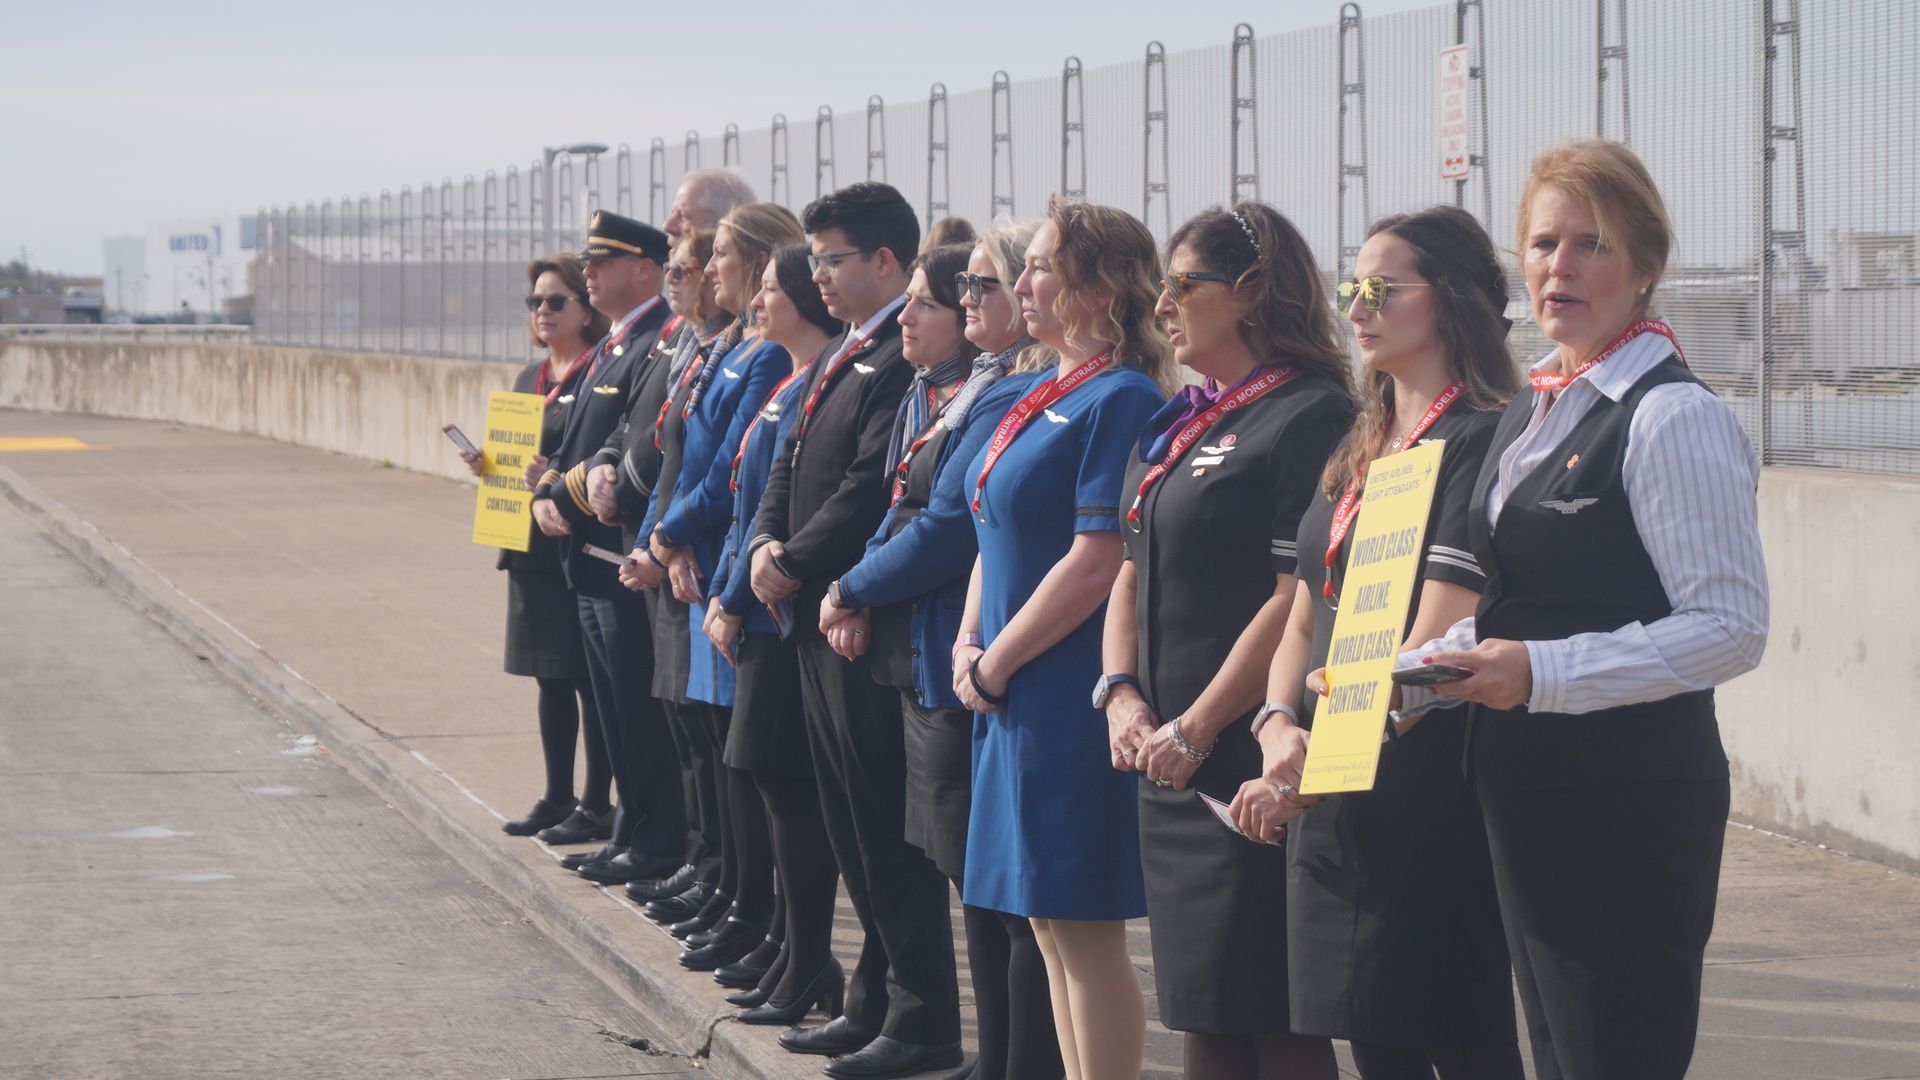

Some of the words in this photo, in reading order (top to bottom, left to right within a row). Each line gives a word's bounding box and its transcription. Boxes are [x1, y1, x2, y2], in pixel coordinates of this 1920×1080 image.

[1058, 359, 1100, 391] CONTRACT
[1220, 400, 1237, 414] NO
[1236, 379, 1268, 404] MORE
[488, 428, 513, 444] WORLD
[513, 431, 536, 448] CLASS
[993, 412, 1019, 451] CONTRACT
[1181, 420, 1204, 444] NOW!
[1410, 409, 1438, 440] MORE
[482, 472, 507, 489] WORLD
[486, 496, 522, 514] CONTRACT
[1352, 533, 1387, 568] WORLD
[1385, 526, 1418, 560] CLASS
[1331, 634, 1365, 666] WORLD
[1364, 628, 1396, 661] CLASS
[1328, 681, 1378, 715] CONTRACT
